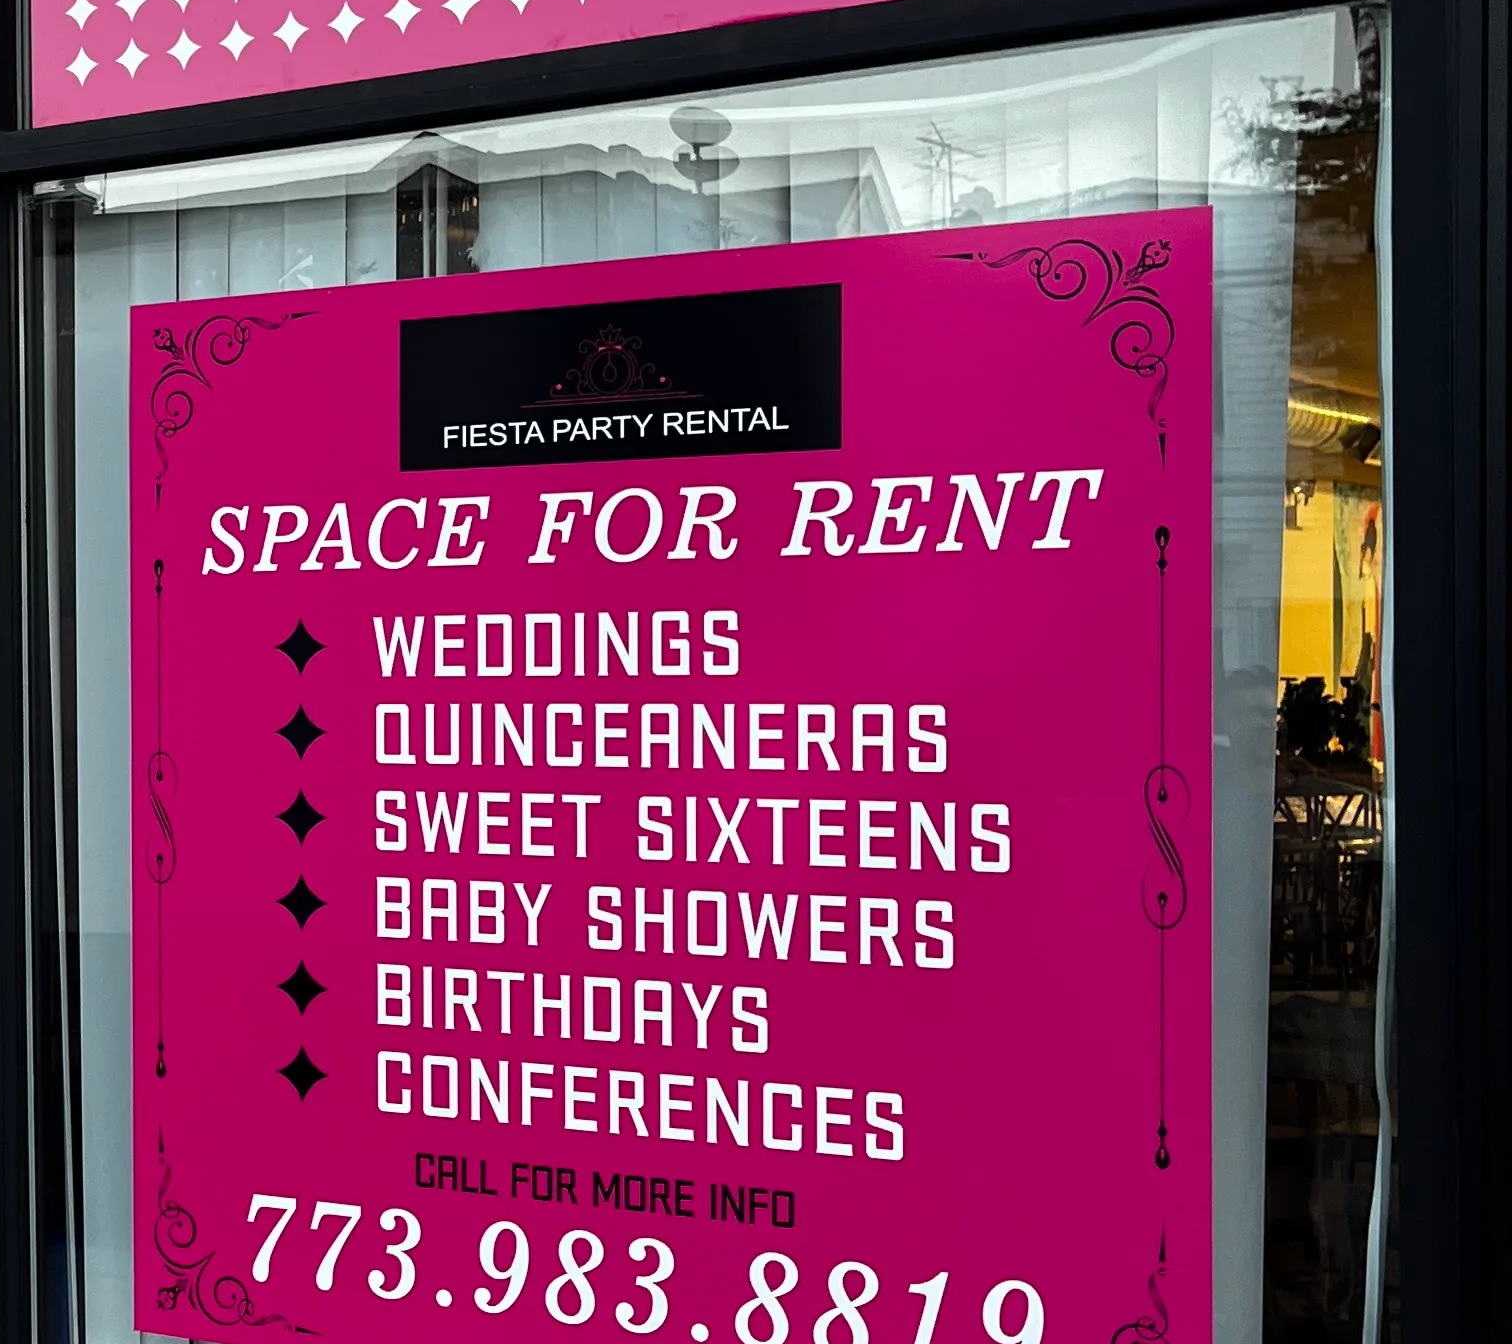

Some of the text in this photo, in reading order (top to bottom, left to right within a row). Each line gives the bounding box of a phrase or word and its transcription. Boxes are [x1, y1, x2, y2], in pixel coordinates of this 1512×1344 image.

[442, 405, 791, 450] FIESTA PARTY RENTAL
[200, 468, 1105, 576] SPACE FOR RENT
[372, 609, 741, 678] WEDDINGS
[374, 702, 948, 774] QUINCEANERAS
[374, 789, 1011, 874] SWEET SIXTEENS
[375, 875, 955, 970] BABY SHOWERS
[376, 962, 769, 1055] BIRTHDAYS
[376, 1049, 905, 1162] CONFERENCES
[414, 1151, 796, 1230] CALL FOR MORE INFO
